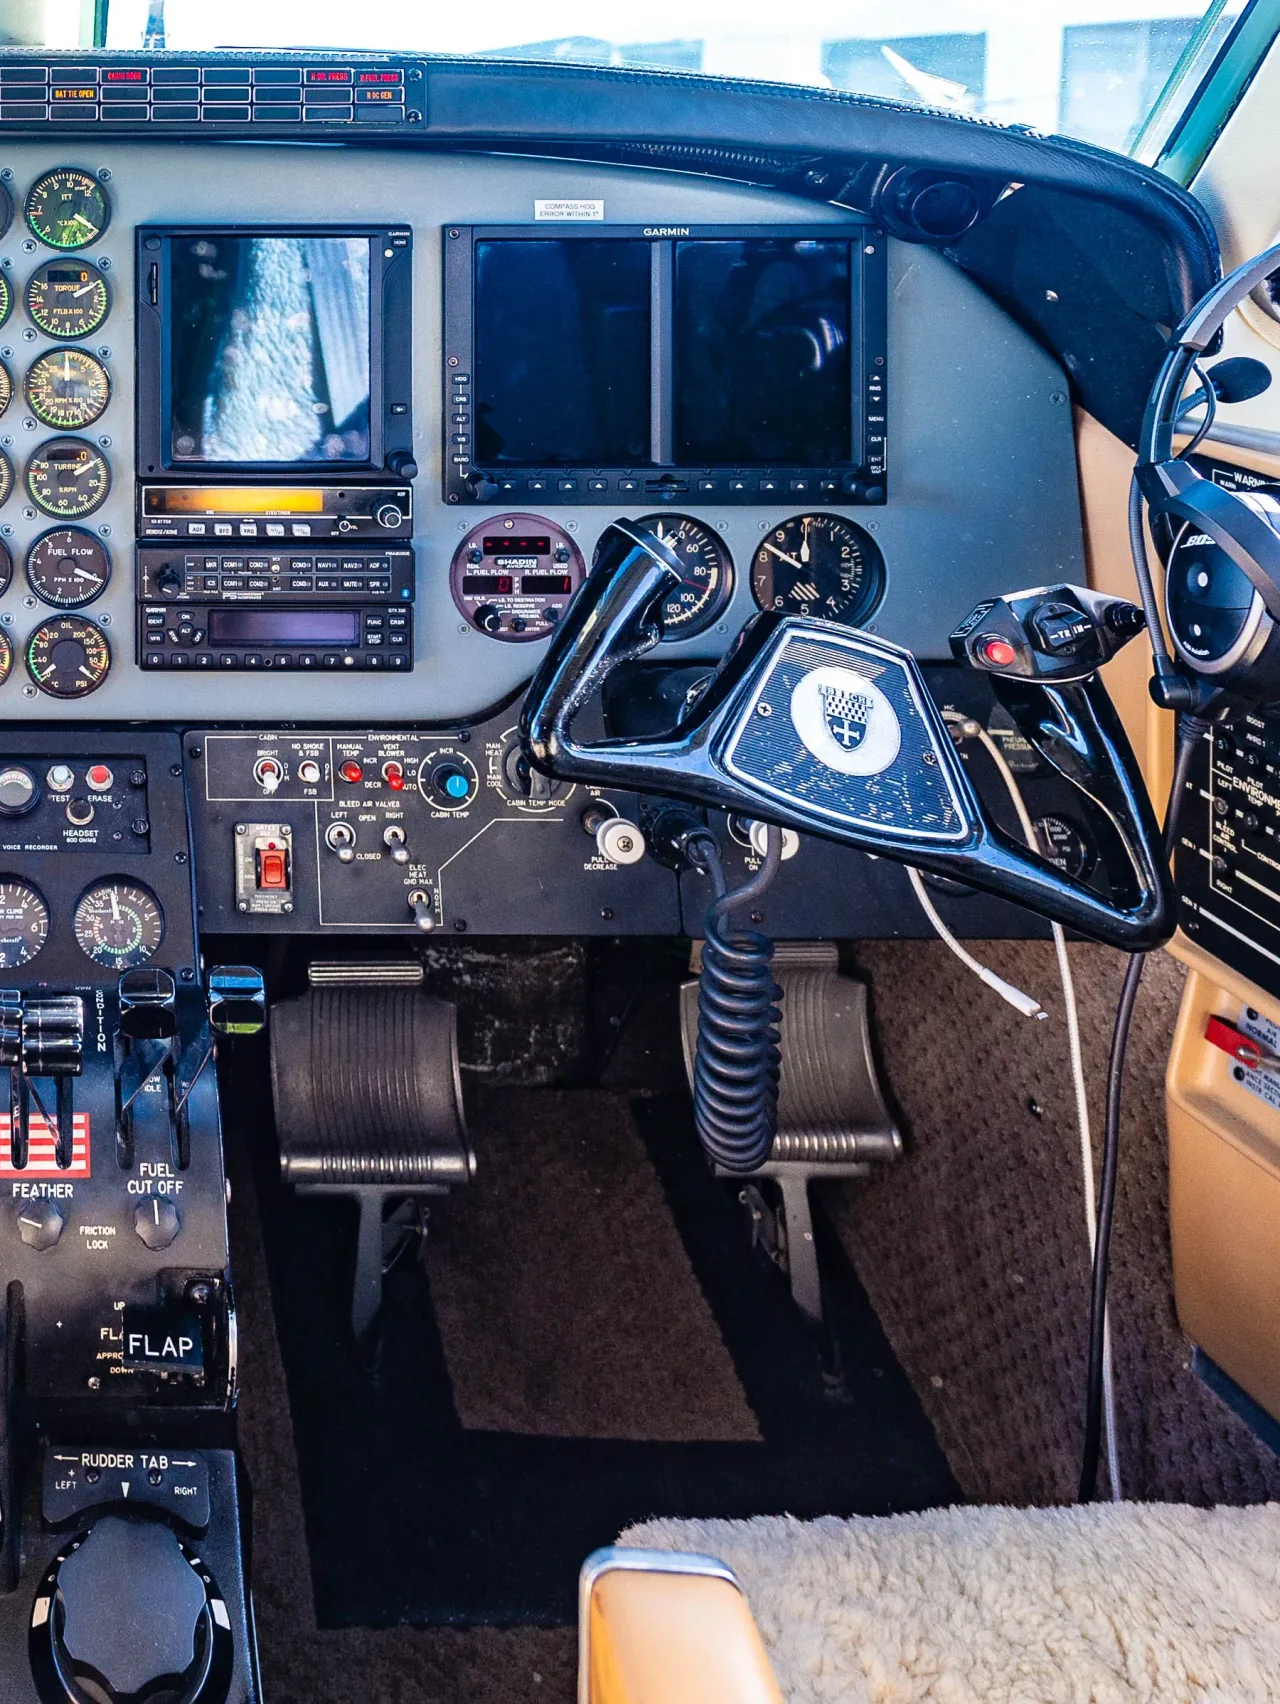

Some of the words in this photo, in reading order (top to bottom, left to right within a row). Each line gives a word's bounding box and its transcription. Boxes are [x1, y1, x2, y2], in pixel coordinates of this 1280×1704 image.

[78, 89, 94, 99] OPEN
[643, 227, 689, 236] GARMIN
[1187, 534, 1217, 546] BOS
[48, 548, 67, 556] FUEL
[71, 548, 93, 556] FLOW
[337, 743, 363, 751] MANUAL
[140, 1163, 174, 1177] FUEL
[12, 1183, 74, 1198] FEATHER
[127, 1180, 151, 1195] CUT
[157, 1180, 183, 1195] OFF
[79, 1226, 116, 1235] FRICTION
[87, 1240, 108, 1249] LOCK
[128, 1335, 193, 1357] FLAP
[81, 1452, 134, 1468] RUDDER
[140, 1454, 169, 1469] TAB
[55, 1481, 77, 1489] LEFT
[174, 1487, 198, 1495] RIGHT
